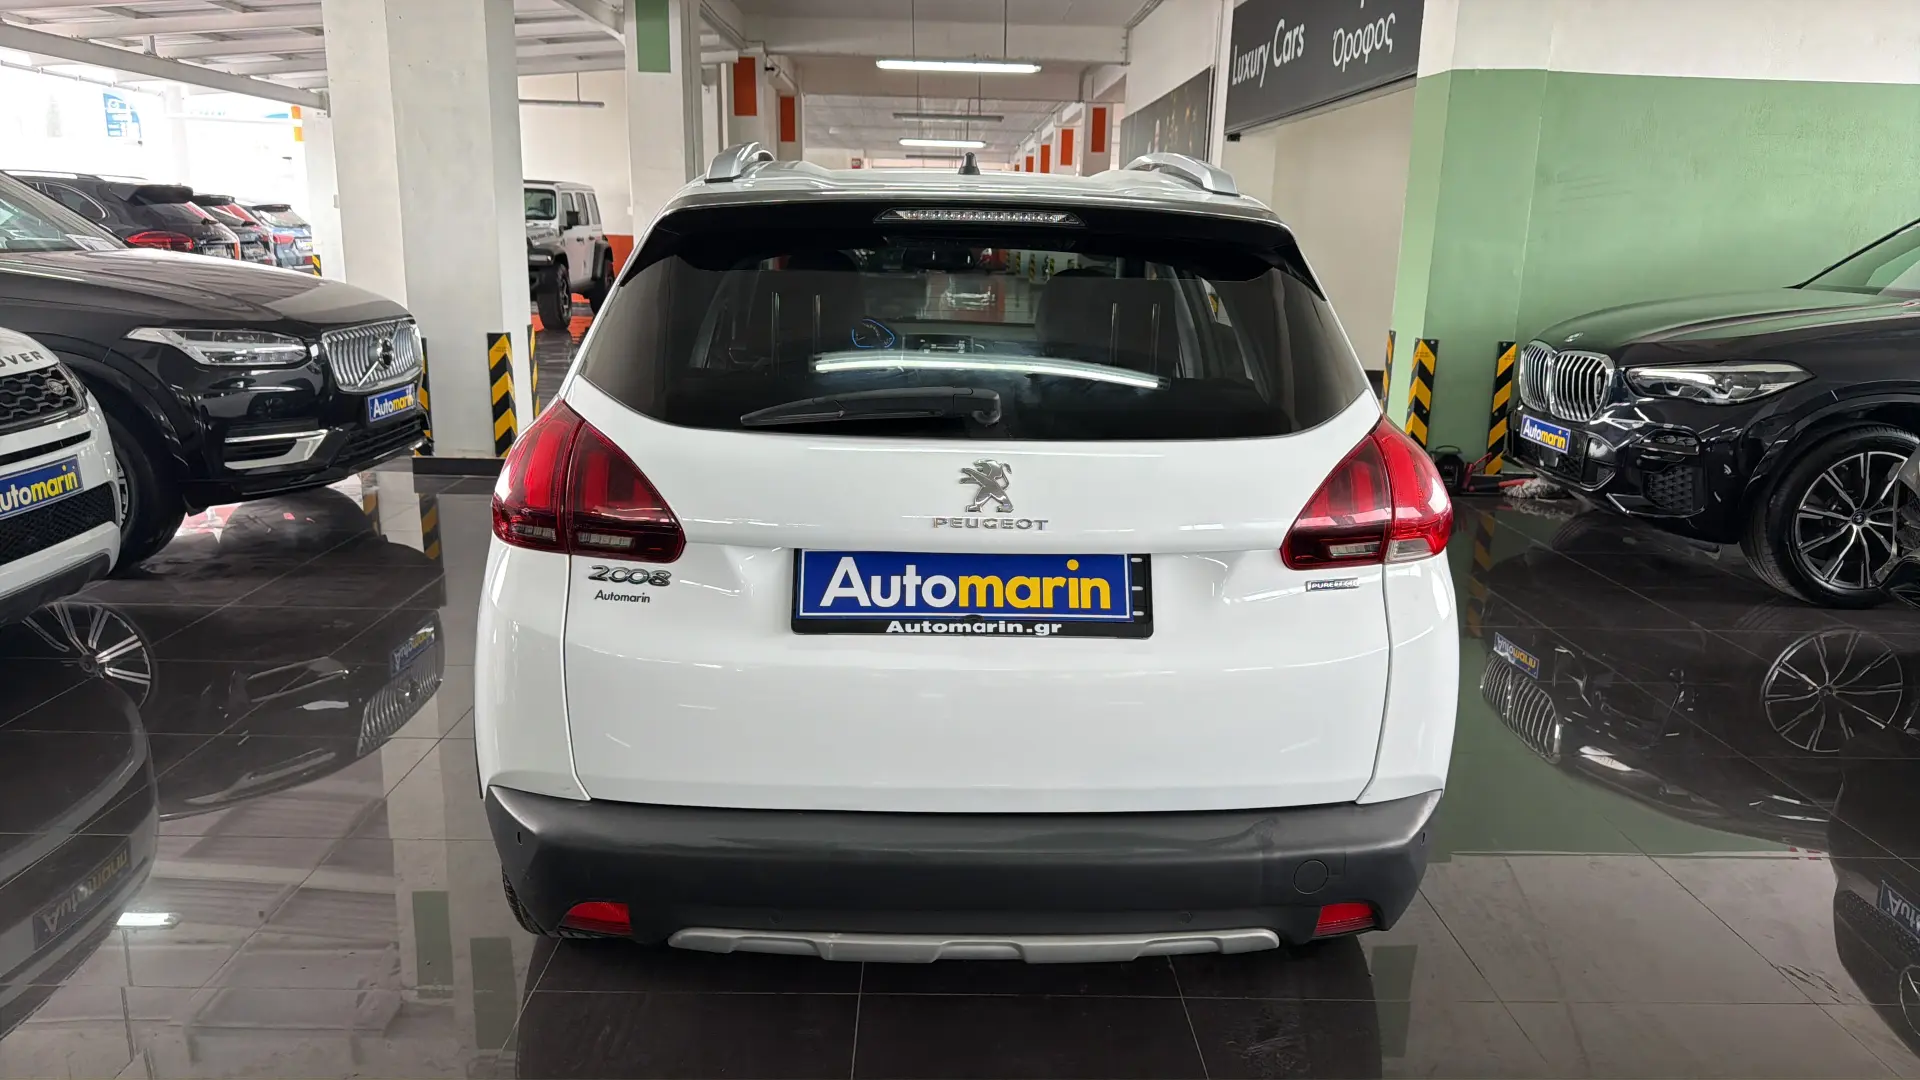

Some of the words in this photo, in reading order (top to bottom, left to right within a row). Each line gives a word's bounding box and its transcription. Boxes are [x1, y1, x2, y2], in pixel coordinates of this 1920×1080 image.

[1232, 41, 1271, 88] Luxury
[1273, 18, 1305, 68] Cars
[1332, 12, 1396, 73] Όροφος
[1523, 419, 1566, 449] Automarin
[0, 465, 78, 512] utomarin
[932, 517, 1049, 531] PEUGEOT
[588, 564, 672, 587] 2008
[819, 556, 1111, 610] Automarin
[594, 589, 651, 603] Automarin
[885, 620, 1062, 636] Automarin.gr
